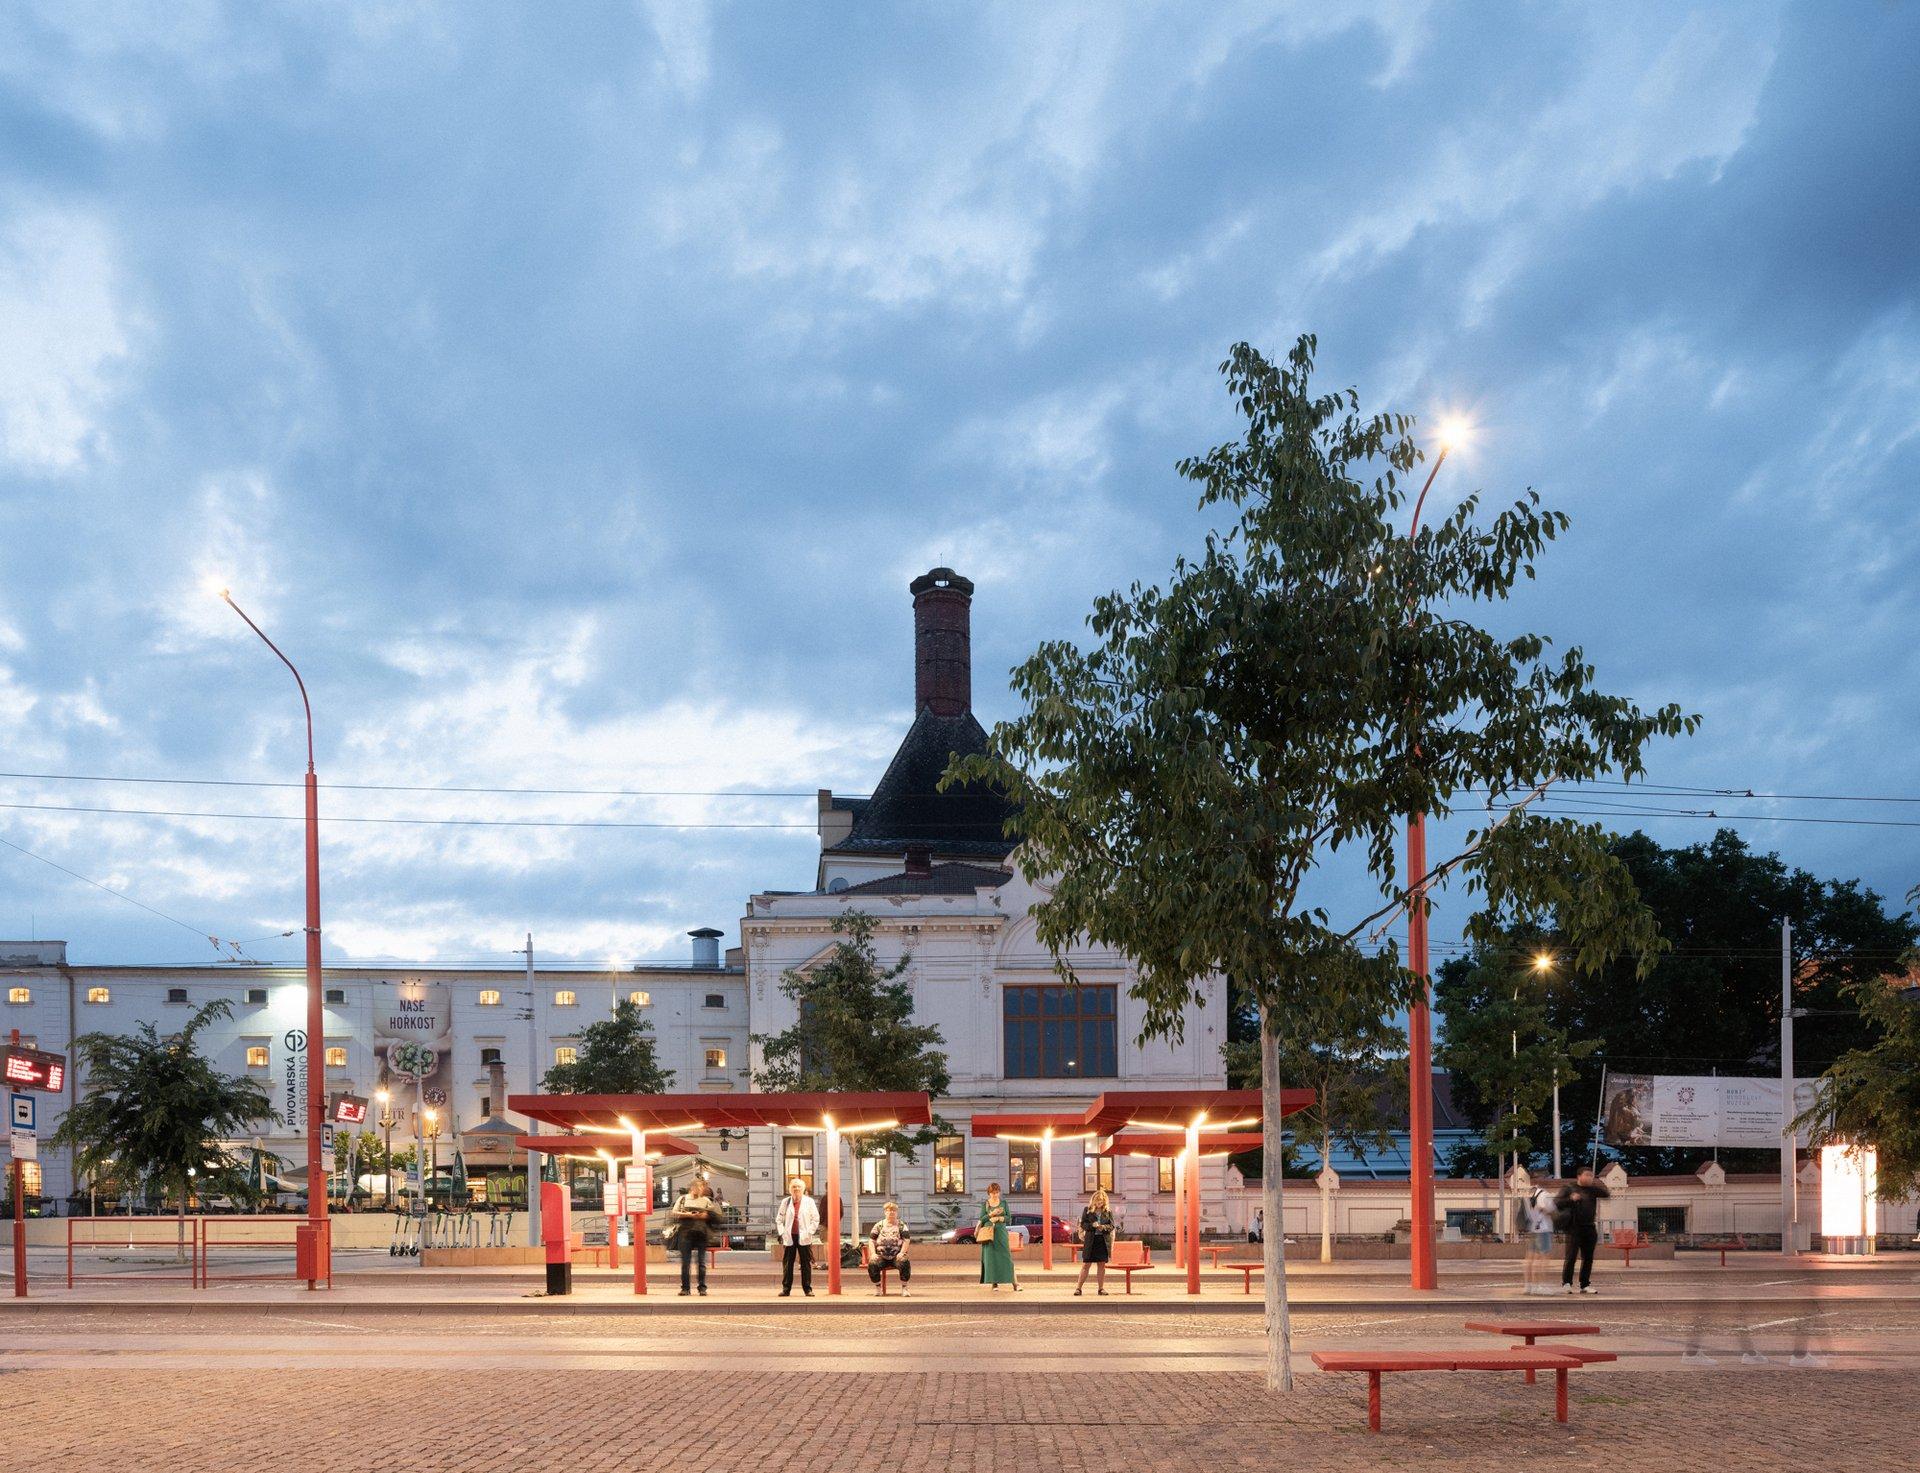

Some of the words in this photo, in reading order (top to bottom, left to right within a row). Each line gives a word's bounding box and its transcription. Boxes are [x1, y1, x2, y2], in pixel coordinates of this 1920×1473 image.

[389, 1015, 436, 1030] HOŘKOST
[284, 1056, 296, 1126] PIVOVARSKÁ
[299, 1055, 308, 1126] STAROBRNO
